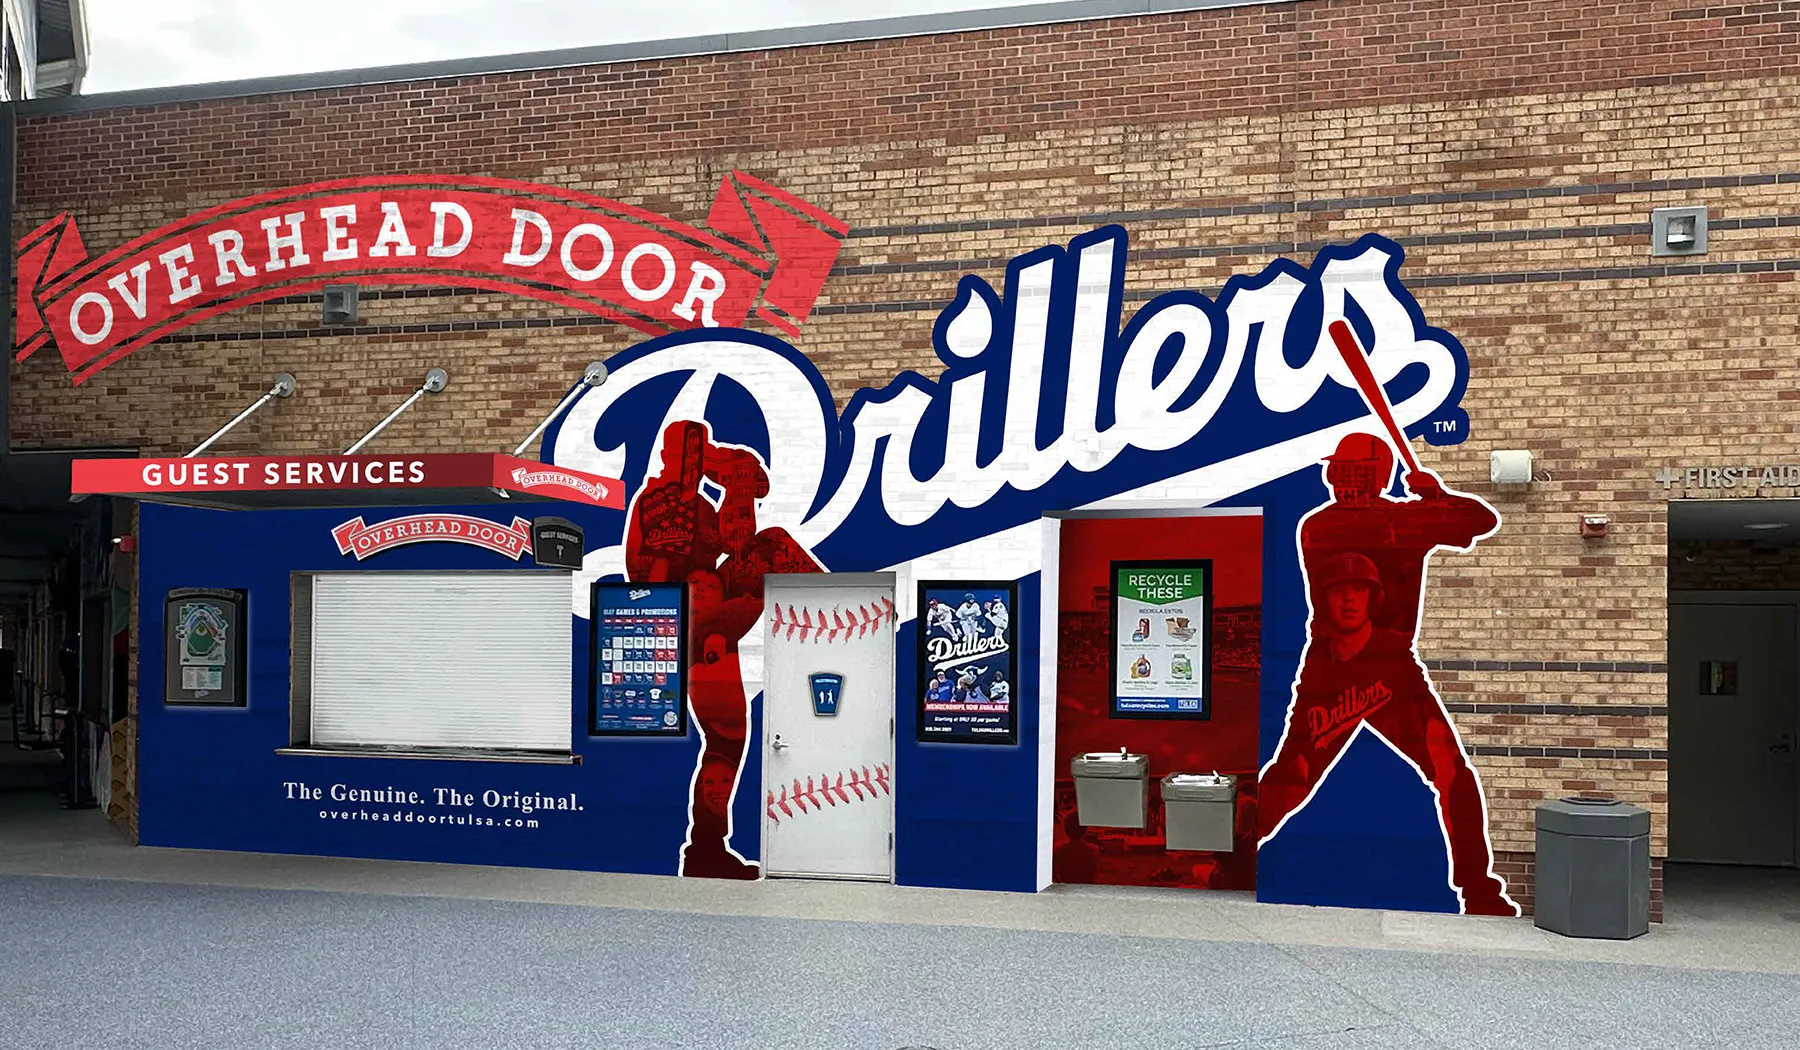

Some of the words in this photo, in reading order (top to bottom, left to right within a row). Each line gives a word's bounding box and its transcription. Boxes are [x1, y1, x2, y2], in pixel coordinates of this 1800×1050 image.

[69, 202, 473, 345] OVERHEAD
[502, 207, 727, 327] DOOR
[553, 238, 1458, 625] Drillers
[1433, 420, 1457, 433] TM
[142, 462, 250, 487] GUEST
[264, 460, 426, 485] SERVICES
[523, 474, 574, 486] OVERHEAD
[576, 480, 600, 500] DOOR
[1685, 466, 1754, 488] FIRST
[1760, 465, 1800, 488] AID
[358, 519, 462, 549] OVERHEAD
[469, 522, 518, 551] DOOR
[1128, 574, 1193, 586] RECYCLE
[1137, 587, 1184, 599] THESE
[927, 631, 1010, 662] Drillers
[1308, 680, 1393, 743] Drillers
[283, 782, 323, 801] The
[330, 784, 425, 805] Genuine.
[434, 787, 474, 807] The
[482, 790, 584, 814] Original.
[319, 809, 540, 829] overheaddoortulsa.com
